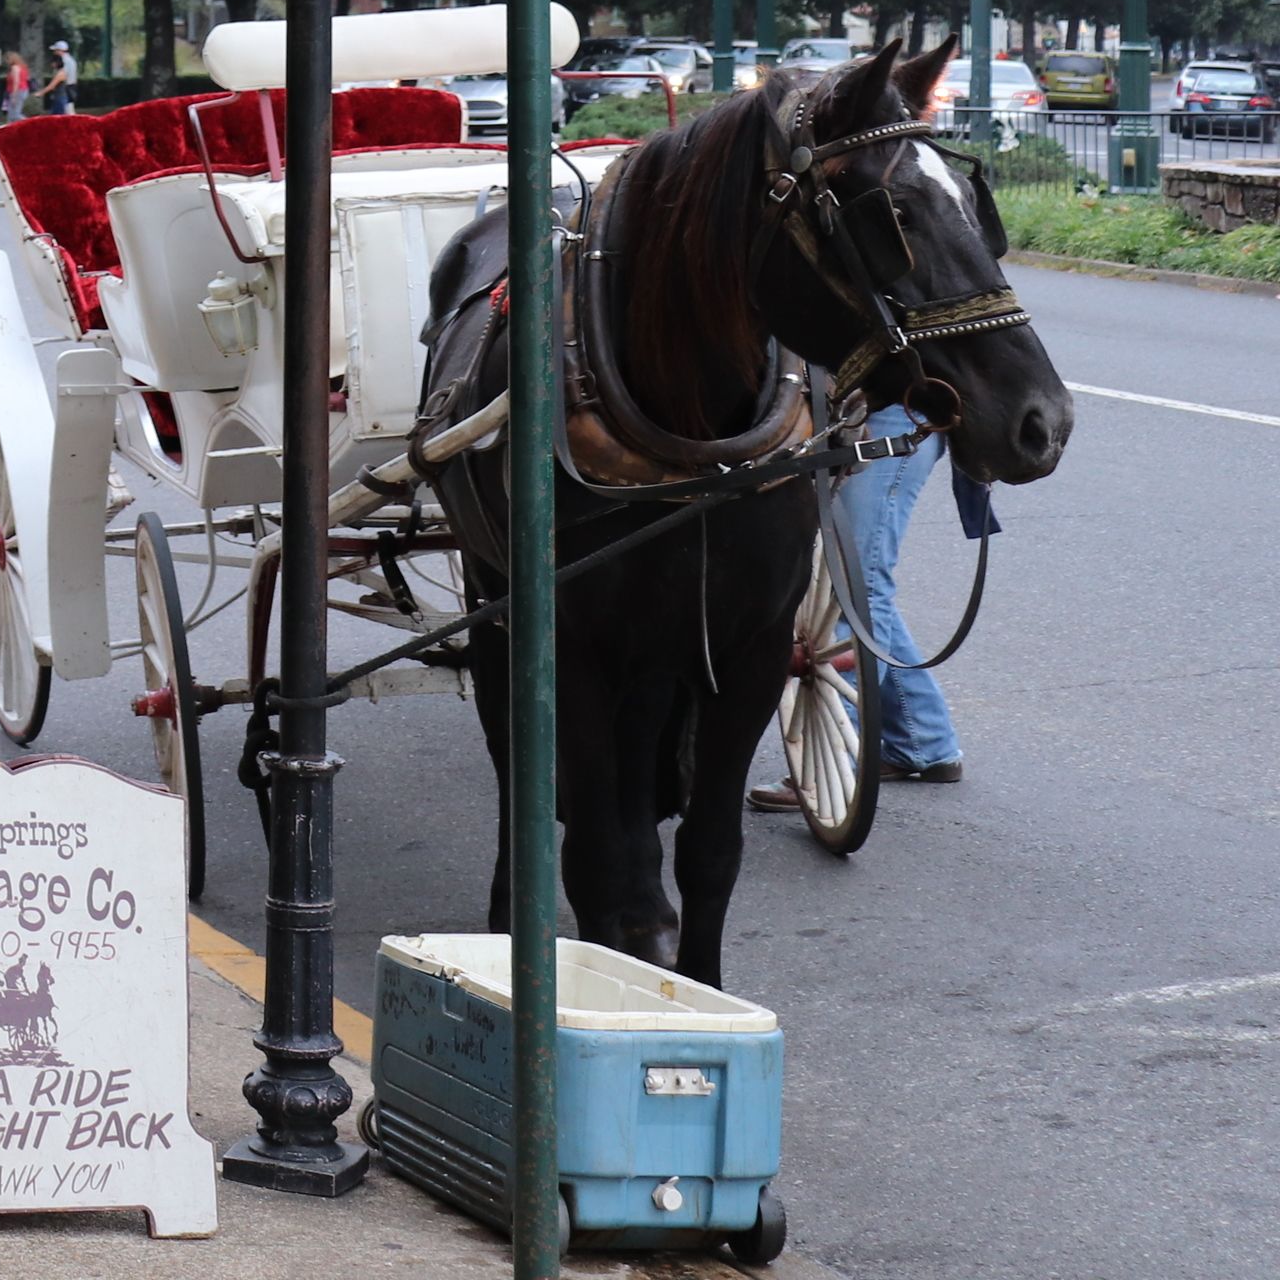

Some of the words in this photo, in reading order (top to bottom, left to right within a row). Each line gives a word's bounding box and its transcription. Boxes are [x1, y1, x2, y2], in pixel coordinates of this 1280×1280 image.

[86, 866, 143, 935] Co.
[28, 1068, 132, 1109] RIDE
[65, 1111, 174, 1151] BACK
